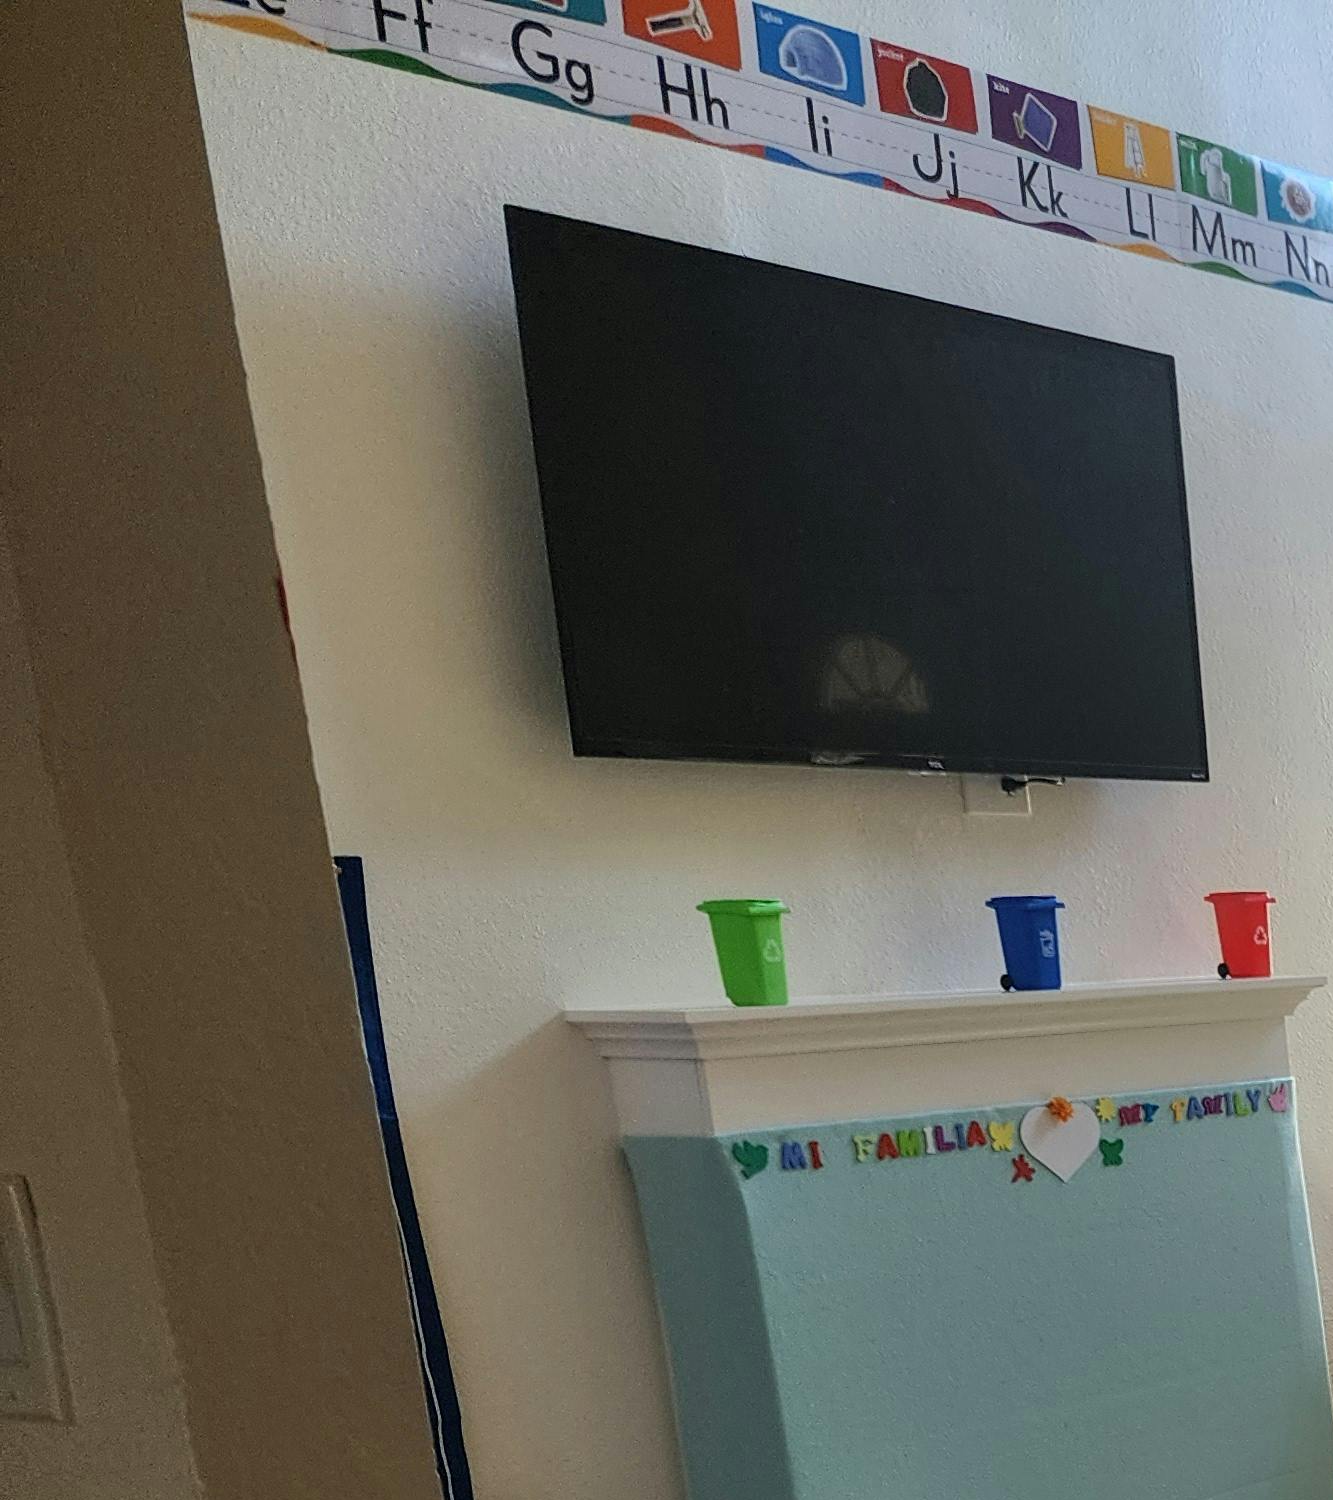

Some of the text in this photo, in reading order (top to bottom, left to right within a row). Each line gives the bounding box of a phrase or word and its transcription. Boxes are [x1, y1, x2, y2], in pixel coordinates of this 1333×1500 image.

[511, 19, 595, 105] Gg
[657, 55, 730, 129] Hh
[806, 97, 833, 156] Ii
[913, 133, 959, 198] Jj
[1017, 156, 1068, 218] Kk
[1126, 187, 1156, 241] Ll
[1192, 205, 1257, 268] Mm
[1285, 232, 1332, 287] Nn
[1118, 1090, 1262, 1126] MY FAMILY
[780, 1120, 988, 1170] MI FAMILIA
